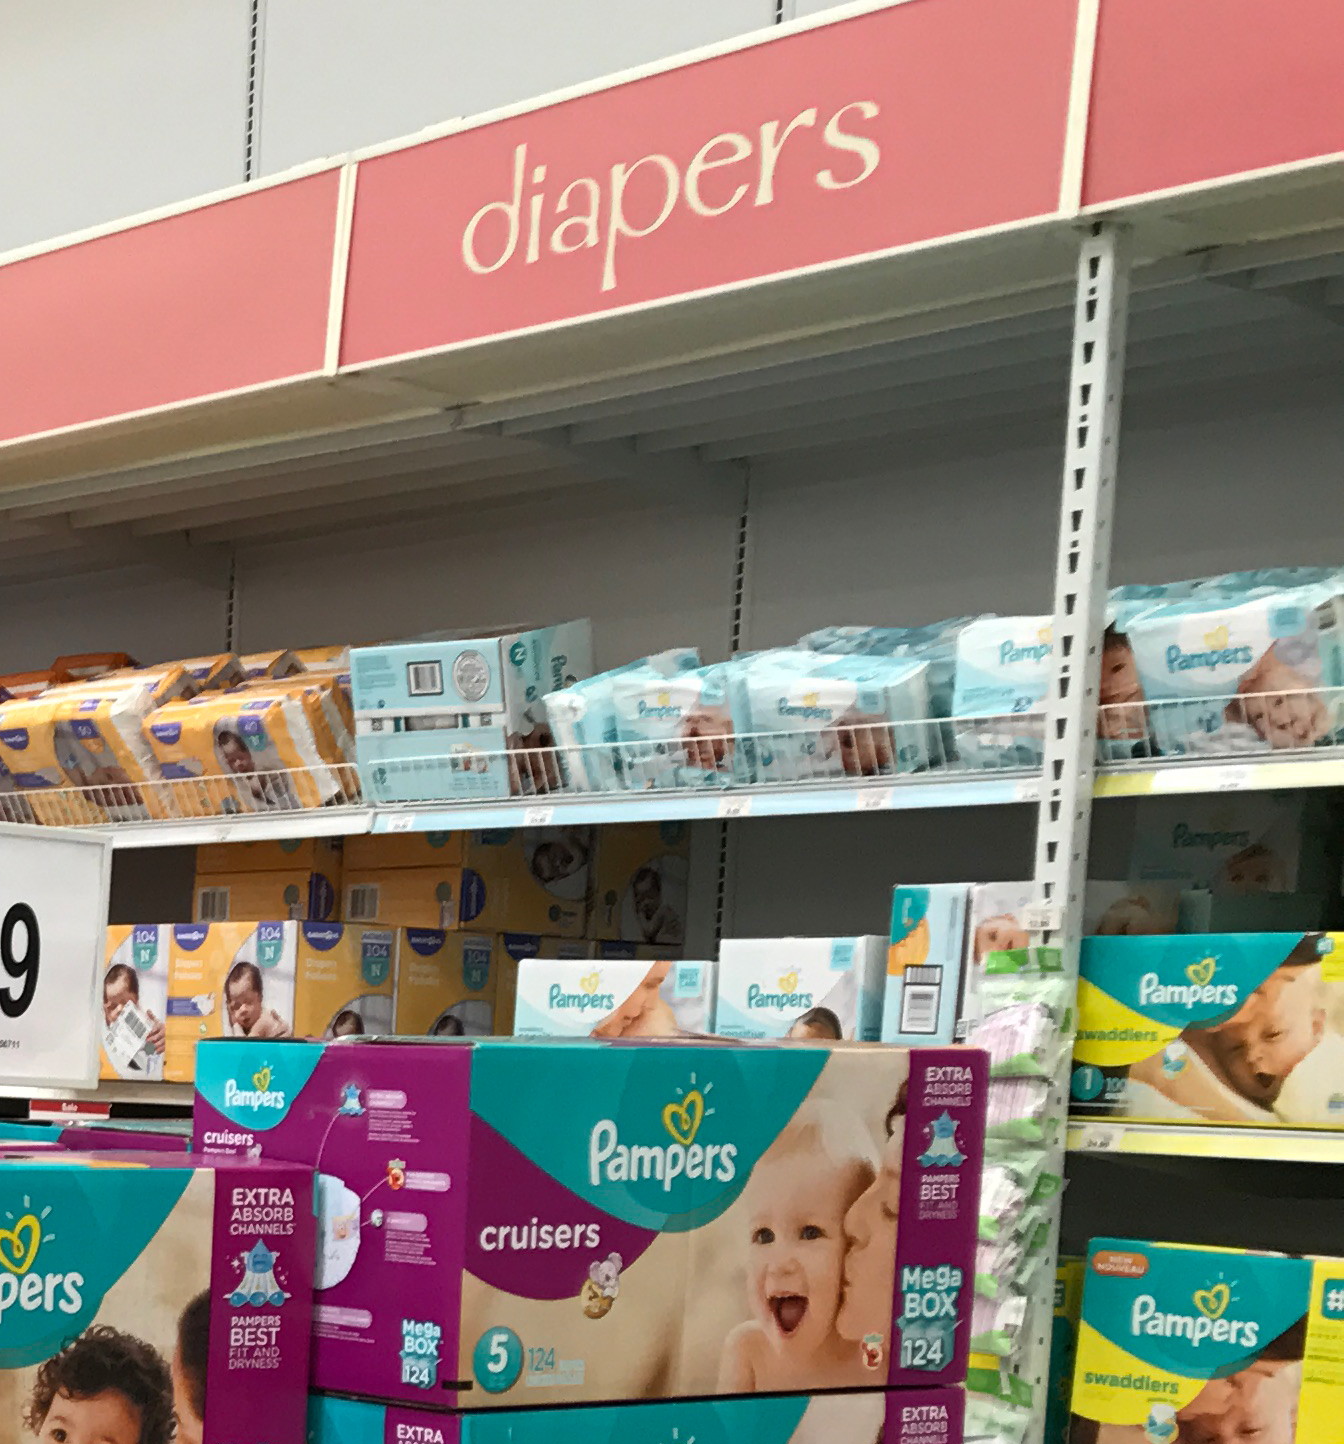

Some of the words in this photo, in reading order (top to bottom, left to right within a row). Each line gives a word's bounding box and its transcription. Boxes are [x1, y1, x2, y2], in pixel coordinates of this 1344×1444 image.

[462, 99, 882, 292] diapers
[1165, 642, 1254, 675] Pampers
[135, 930, 156, 944] 104
[140, 948, 151, 962] N
[549, 986, 614, 1013] Pampers
[747, 986, 813, 1013] Pampers
[1139, 972, 1238, 1009] Pampers
[1075, 1029, 1157, 1042] waddlers
[925, 1066, 973, 1083] EXTRA
[224, 1077, 285, 1112] Pampers
[203, 1129, 254, 1147] cruisers
[589, 1120, 737, 1192] Pampers
[232, 1187, 295, 1208] EXTRA
[920, 1183, 959, 1201] BEST
[231, 1205, 294, 1223] ABSORB
[230, 1221, 294, 1237] CHANNELS
[480, 1217, 600, 1253] cruisers
[231, 1315, 282, 1328] PAMPERS
[1131, 1294, 1259, 1348] Pampers
[230, 1327, 281, 1347] BEST
[229, 1345, 250, 1358] FIT
[253, 1345, 281, 1358] AND
[487, 1334, 509, 1373] 5
[528, 1348, 555, 1371] 124
[901, 1337, 943, 1367] 124
[228, 1356, 280, 1371] DRYNESS
[1084, 1370, 1179, 1395] swaddlers
